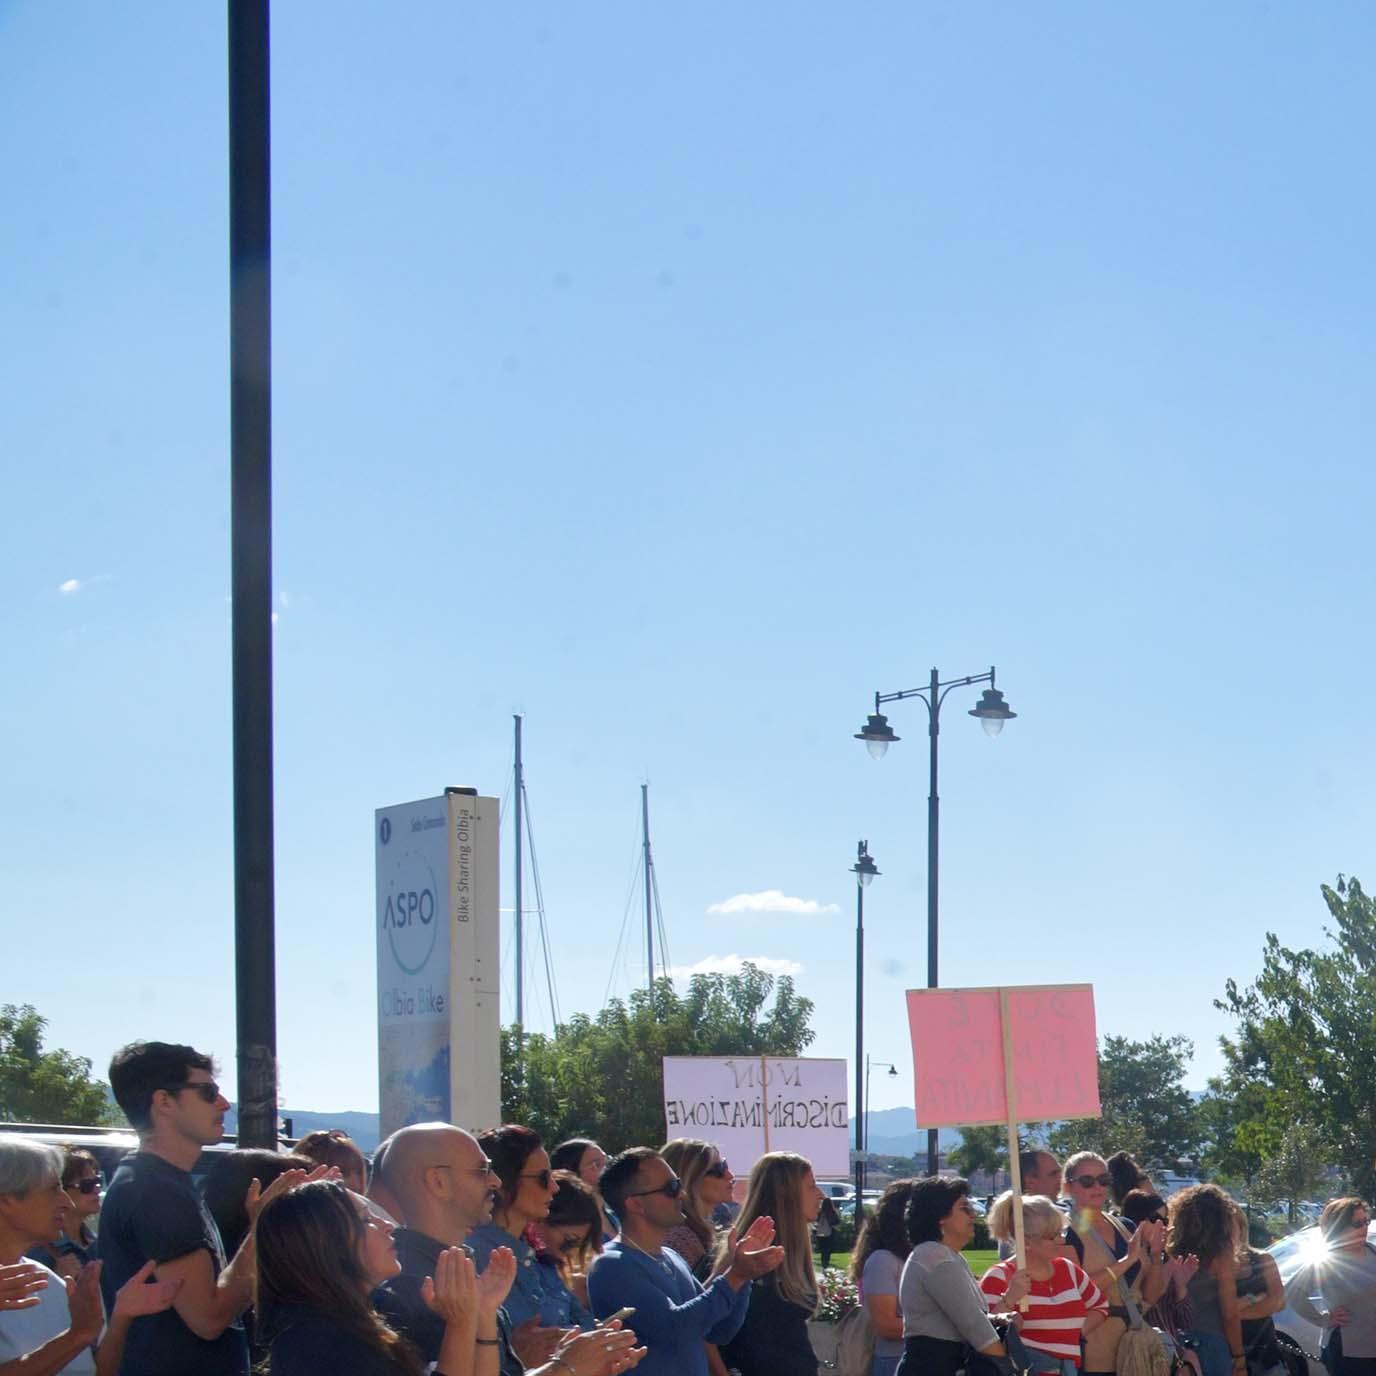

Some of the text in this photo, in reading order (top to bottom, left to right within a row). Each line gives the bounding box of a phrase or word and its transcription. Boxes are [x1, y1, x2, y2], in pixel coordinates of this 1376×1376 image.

[456, 808, 472, 923] Bike Sharing Olbia
[383, 888, 434, 930] ASPO
[383, 984, 445, 1017] Olbia Bike
